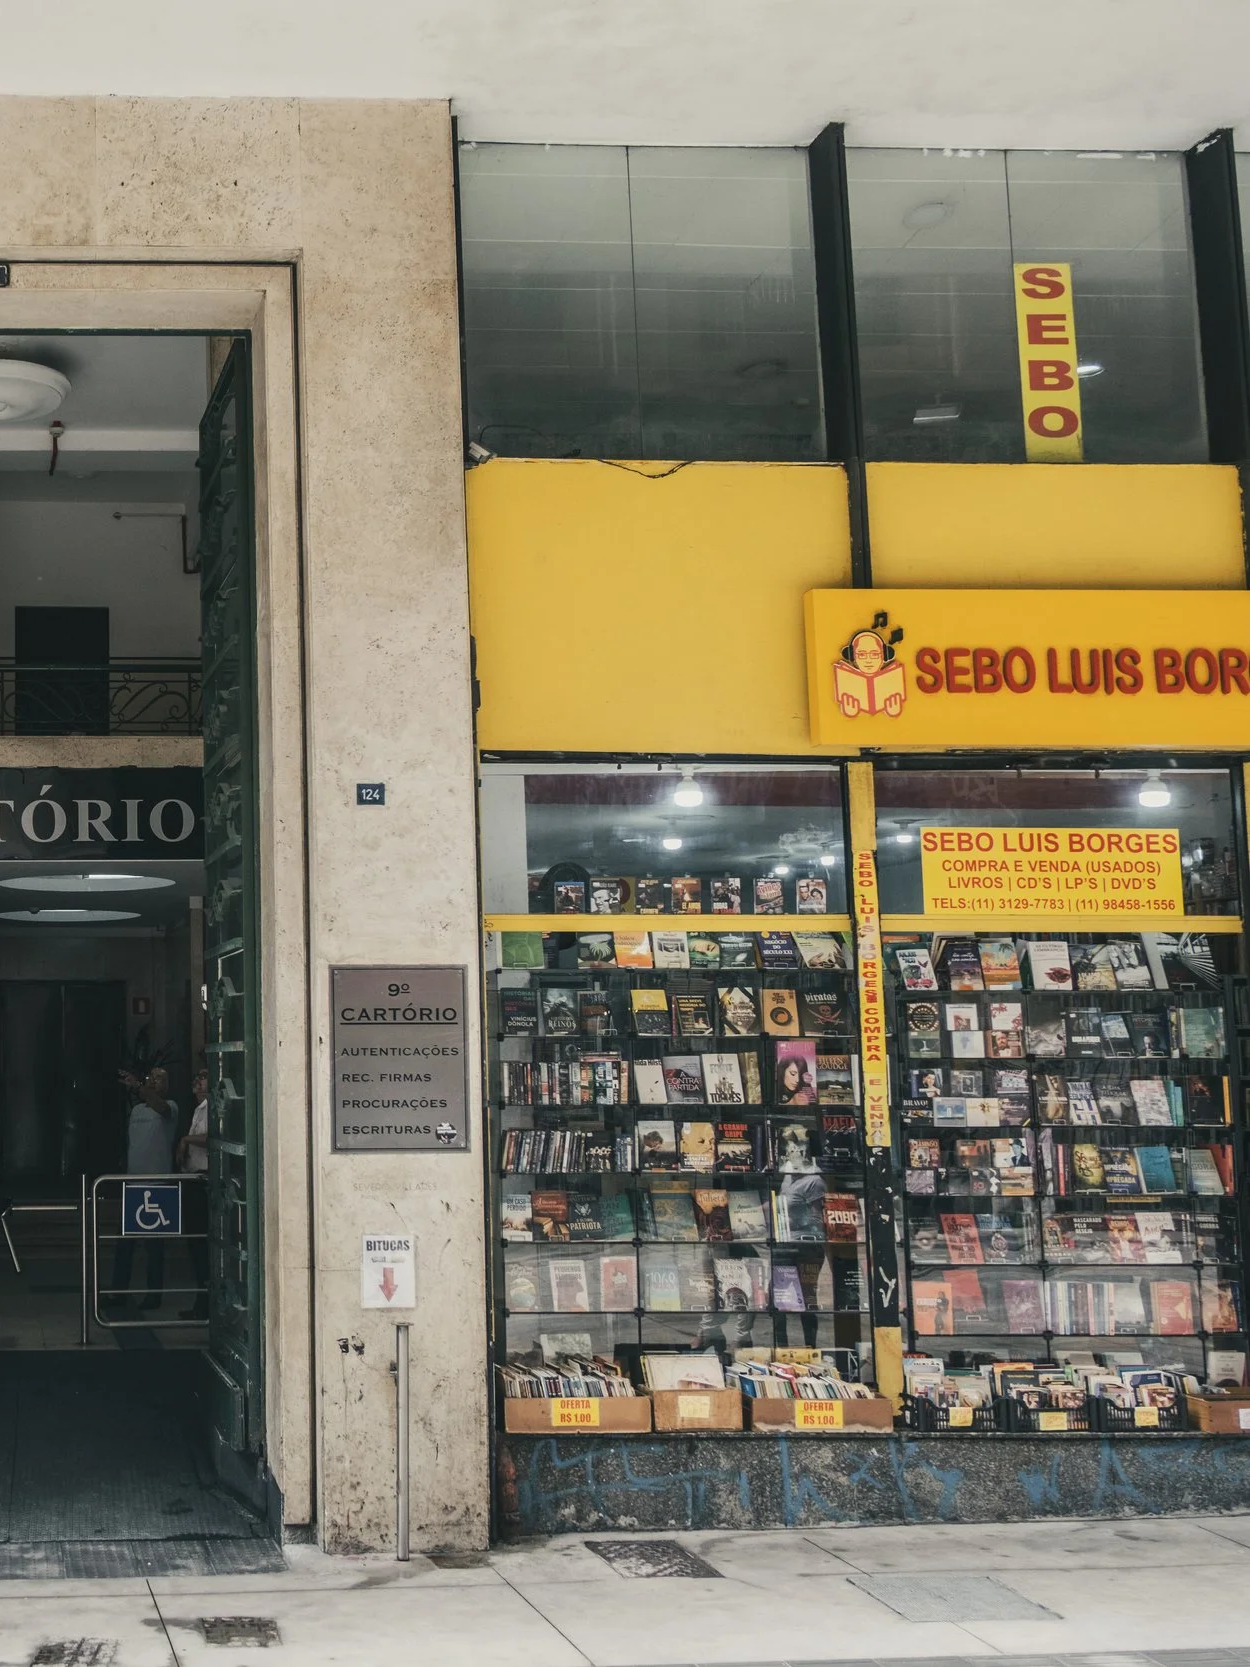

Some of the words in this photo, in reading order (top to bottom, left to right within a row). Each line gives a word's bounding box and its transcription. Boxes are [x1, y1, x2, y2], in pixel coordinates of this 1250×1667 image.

[1021, 268, 1079, 438] SEBO
[915, 646, 1036, 695] SEBO
[1046, 647, 1144, 696] LUIS
[1154, 647, 1250, 696] BOR
[361, 789, 380, 800] 124
[922, 832, 994, 853] SEBO
[1003, 832, 1060, 853] LUIS
[1069, 833, 1179, 855] BORGES
[858, 852, 874, 887] SEBO
[942, 860, 1009, 873] COMPRA
[1014, 861, 1023, 871] E
[1028, 861, 1081, 873] VENDA
[1086, 861, 1162, 877] (USADOS)
[948, 877, 1003, 889] LIVROS
[999, 898, 1064, 910] 3129-7783
[1076, 898, 1099, 912] (11)
[1103, 898, 1175, 911] 98458-1556
[860, 897, 875, 933] LUIS
[388, 983, 411, 997] 9º
[340, 1003, 458, 1022] CARTÓRIO
[863, 1007, 881, 1062] COMPRA
[340, 1045, 459, 1059] AUTENTICAÇÕES
[342, 1073, 374, 1083] REC.
[380, 1073, 432, 1083] FIRMAS
[342, 1097, 448, 1111] PROCURAÇÕES
[342, 1125, 432, 1135] ESCRITURAS
[366, 1239, 410, 1251] BITUCAS
[560, 1399, 591, 1409] OFERTA
[803, 1402, 834, 1411] OFERTA
[560, 1413, 572, 1423] R$
[803, 1415, 815, 1425] R$
